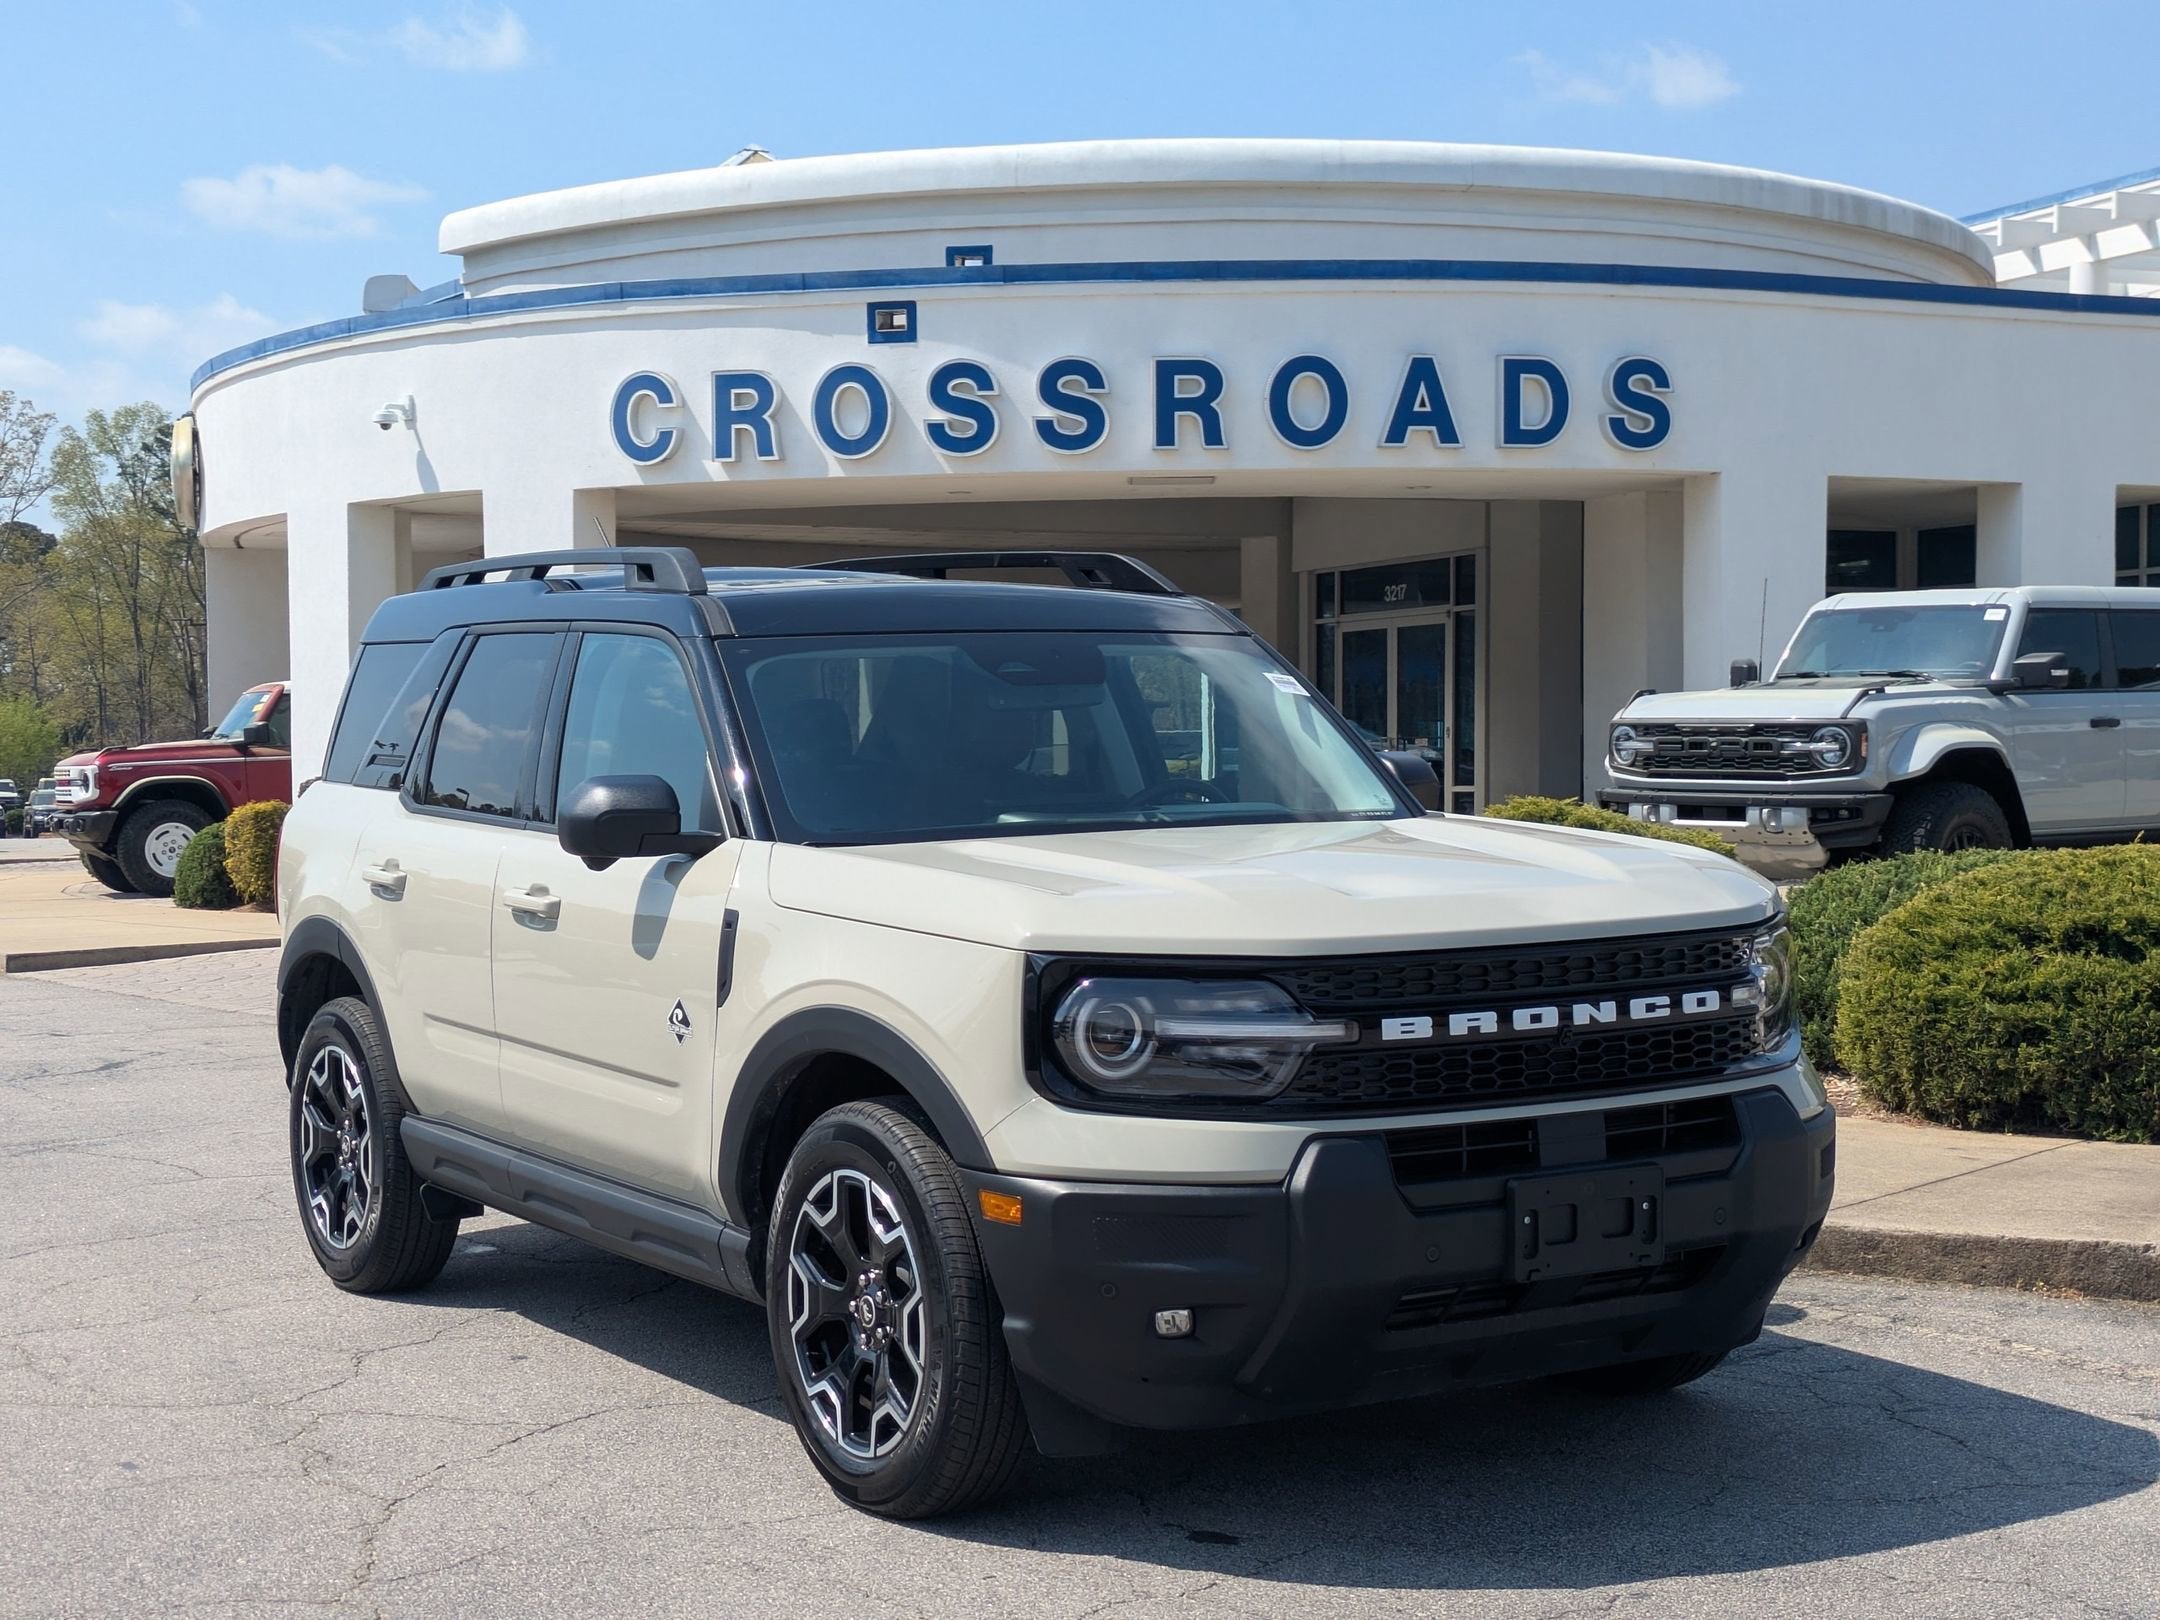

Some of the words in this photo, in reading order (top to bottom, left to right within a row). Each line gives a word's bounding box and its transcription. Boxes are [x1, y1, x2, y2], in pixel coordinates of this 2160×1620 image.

[612, 354, 1674, 461] CROSSROADS
[1384, 583, 1407, 602] 3217
[1381, 990, 1720, 1041] BRONCO
